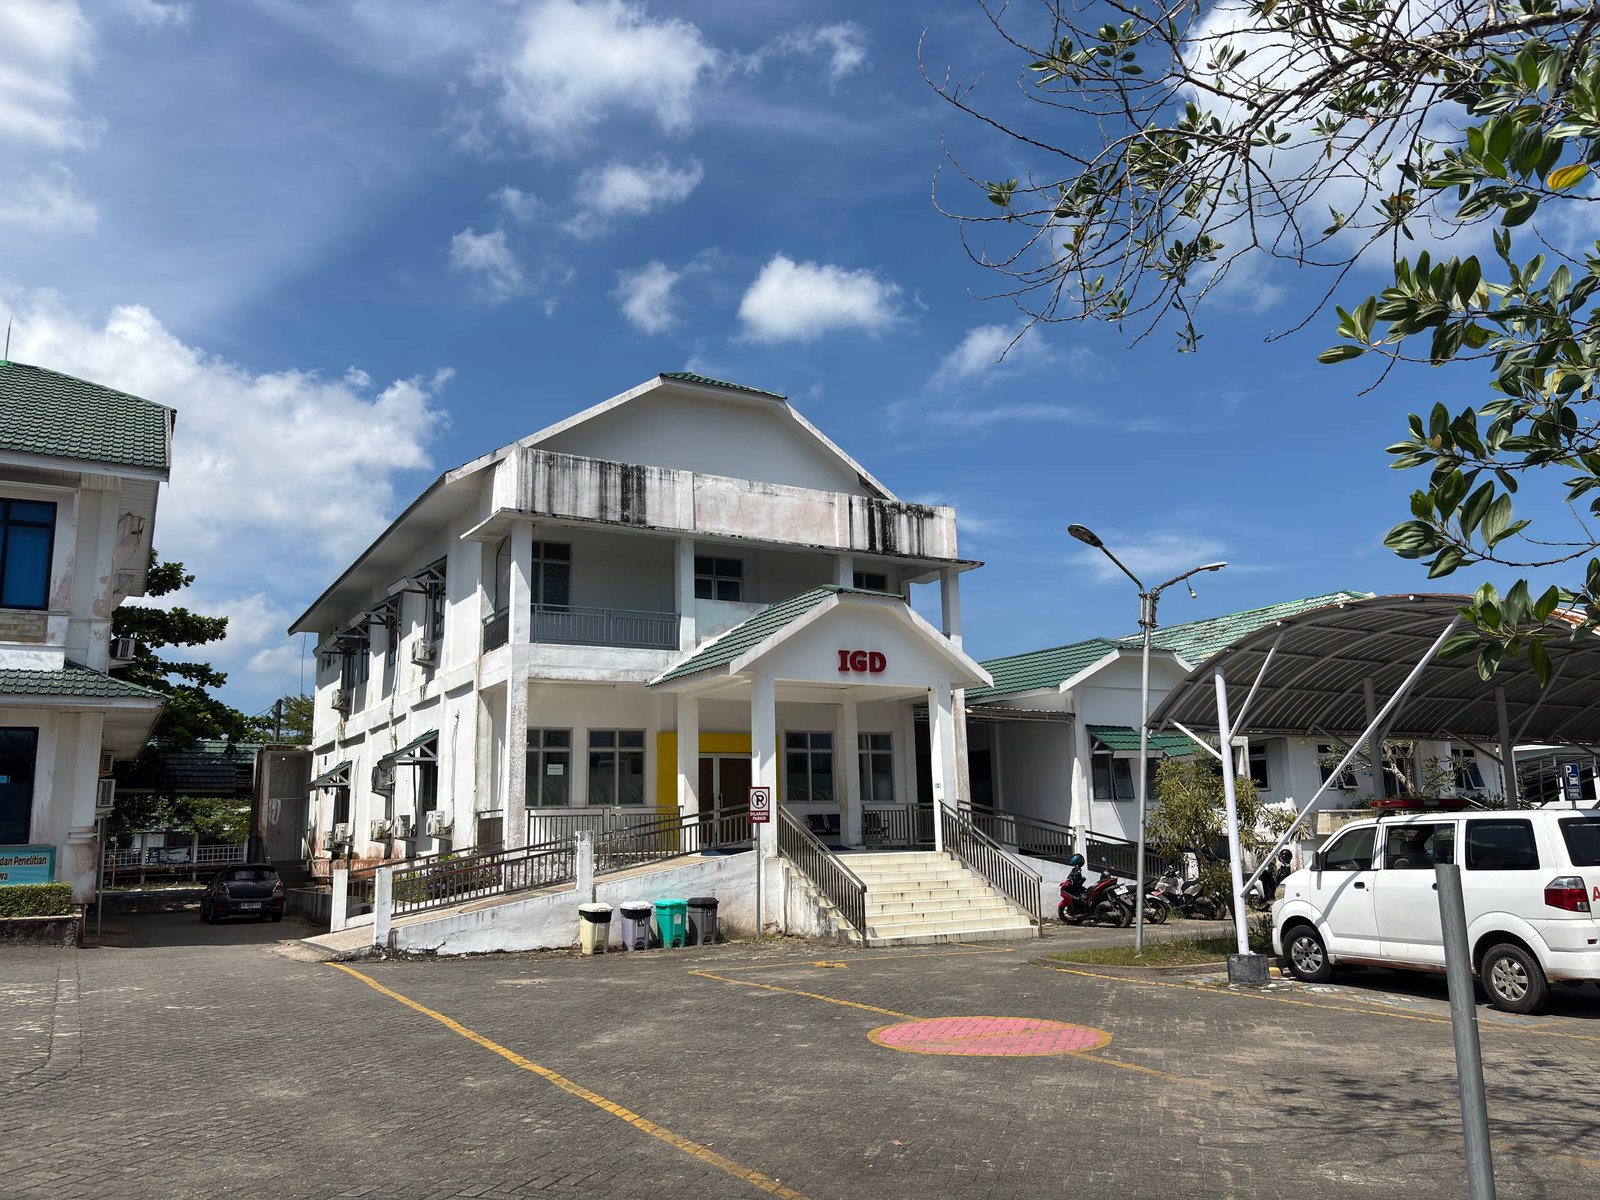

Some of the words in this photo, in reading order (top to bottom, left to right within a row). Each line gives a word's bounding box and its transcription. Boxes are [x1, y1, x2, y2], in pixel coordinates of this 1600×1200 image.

[837, 650, 887, 672] IGD
[1566, 766, 1572, 777] P
[0, 857, 12, 866] dan
[14, 855, 47, 866] Penelitian
